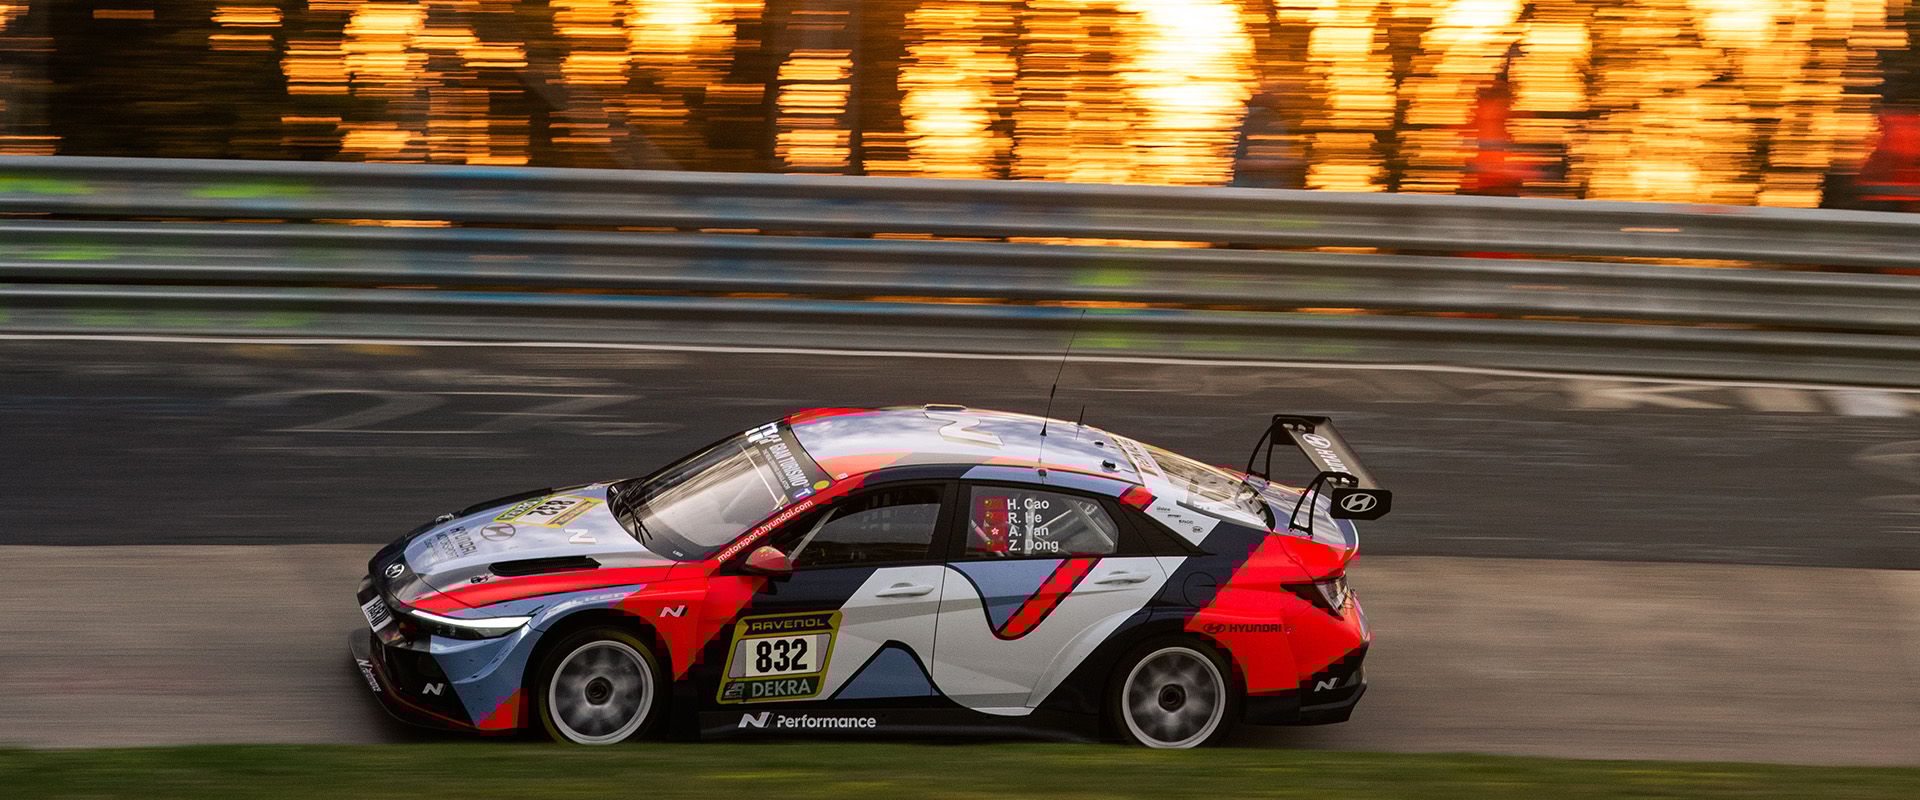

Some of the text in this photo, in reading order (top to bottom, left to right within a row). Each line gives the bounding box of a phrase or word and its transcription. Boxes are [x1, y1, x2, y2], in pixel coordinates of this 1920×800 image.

[526, 500, 575, 516] 832
[1007, 498, 1050, 510] H. Cao
[1008, 512, 1042, 523] R. He
[718, 500, 813, 562] motorsport.hyundai.com
[1008, 524, 1049, 537] A. Yan
[449, 525, 477, 556] HYUNDAI
[1009, 539, 1059, 552] Z. Dong
[752, 619, 825, 631] RAVENOL
[1229, 624, 1282, 633] HYUNDAI
[756, 639, 808, 673] 832
[422, 682, 445, 696] N
[752, 679, 811, 697] DEKRA
[1314, 677, 1338, 692] N
[738, 711, 876, 728] N Performance
